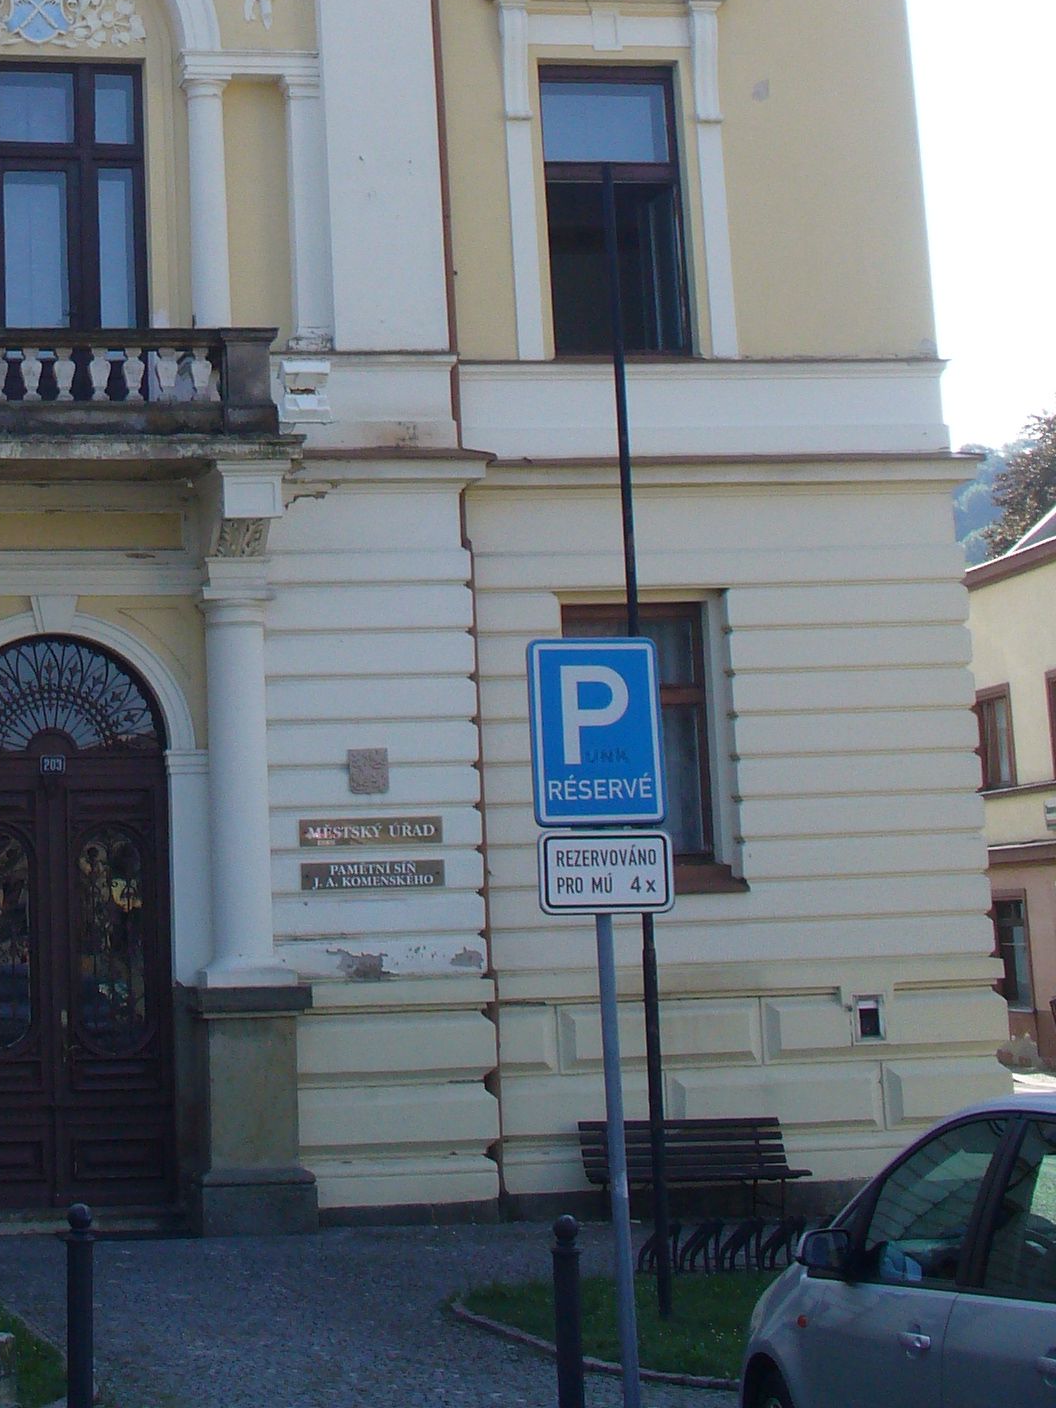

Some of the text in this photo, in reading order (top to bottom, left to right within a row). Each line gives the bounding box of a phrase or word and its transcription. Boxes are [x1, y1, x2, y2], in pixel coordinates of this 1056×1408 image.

[560, 665, 629, 765] P
[43, 758, 62, 771] 203
[548, 772, 653, 801] RÉSERVÉ
[389, 823, 435, 837] ÚŘAD
[556, 844, 657, 868] REZERVOVÁNO
[330, 860, 390, 876] PAMĚTNÍ
[312, 872, 434, 890] J. A. KOMENSKÉHO
[557, 877, 583, 895] PRO
[592, 873, 613, 894] MÚ
[630, 876, 642, 893] 4
